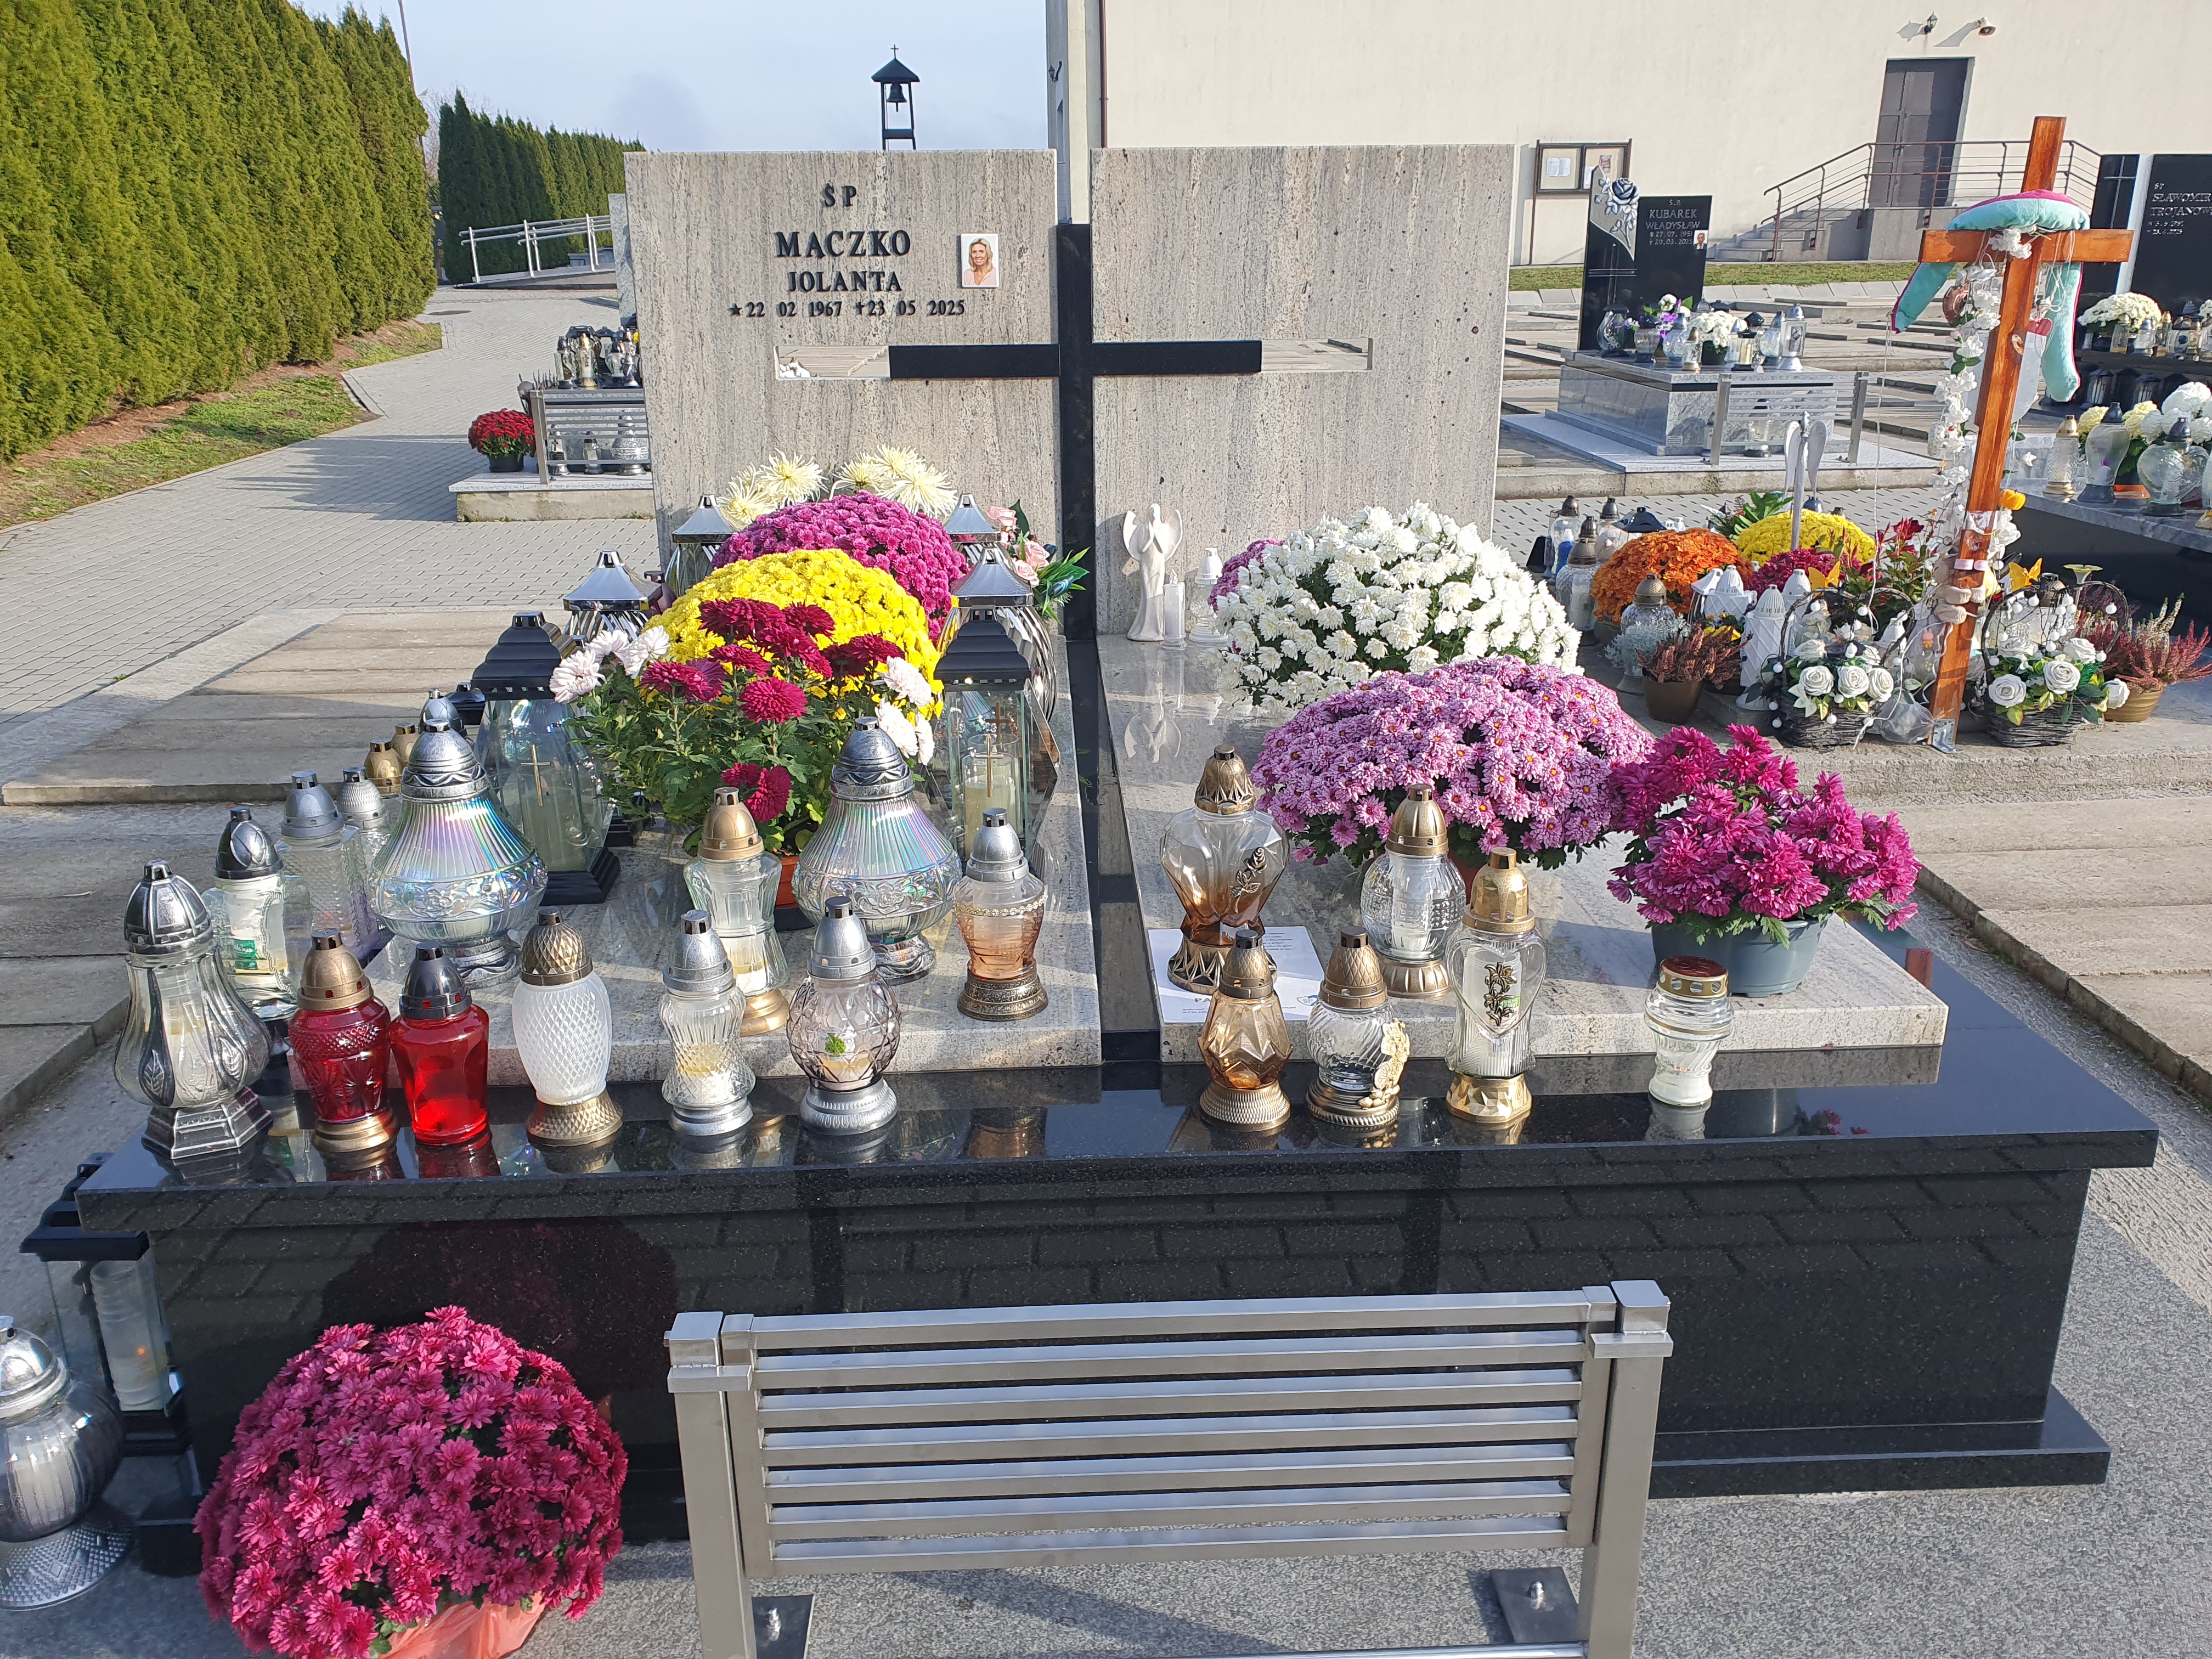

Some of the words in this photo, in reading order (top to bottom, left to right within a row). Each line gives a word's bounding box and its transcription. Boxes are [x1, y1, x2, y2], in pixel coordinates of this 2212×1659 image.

[1649, 208, 1697, 219] KUBAREK
[1645, 221, 1701, 230] WŁADYSŁAW
[788, 270, 903, 292] JOLANTA
[746, 301, 766, 318] 22
[776, 301, 797, 317] 02
[808, 301, 843, 317] 1967
[866, 300, 885, 317] 23
[896, 300, 916, 317] 05
[928, 299, 965, 317] 2025
